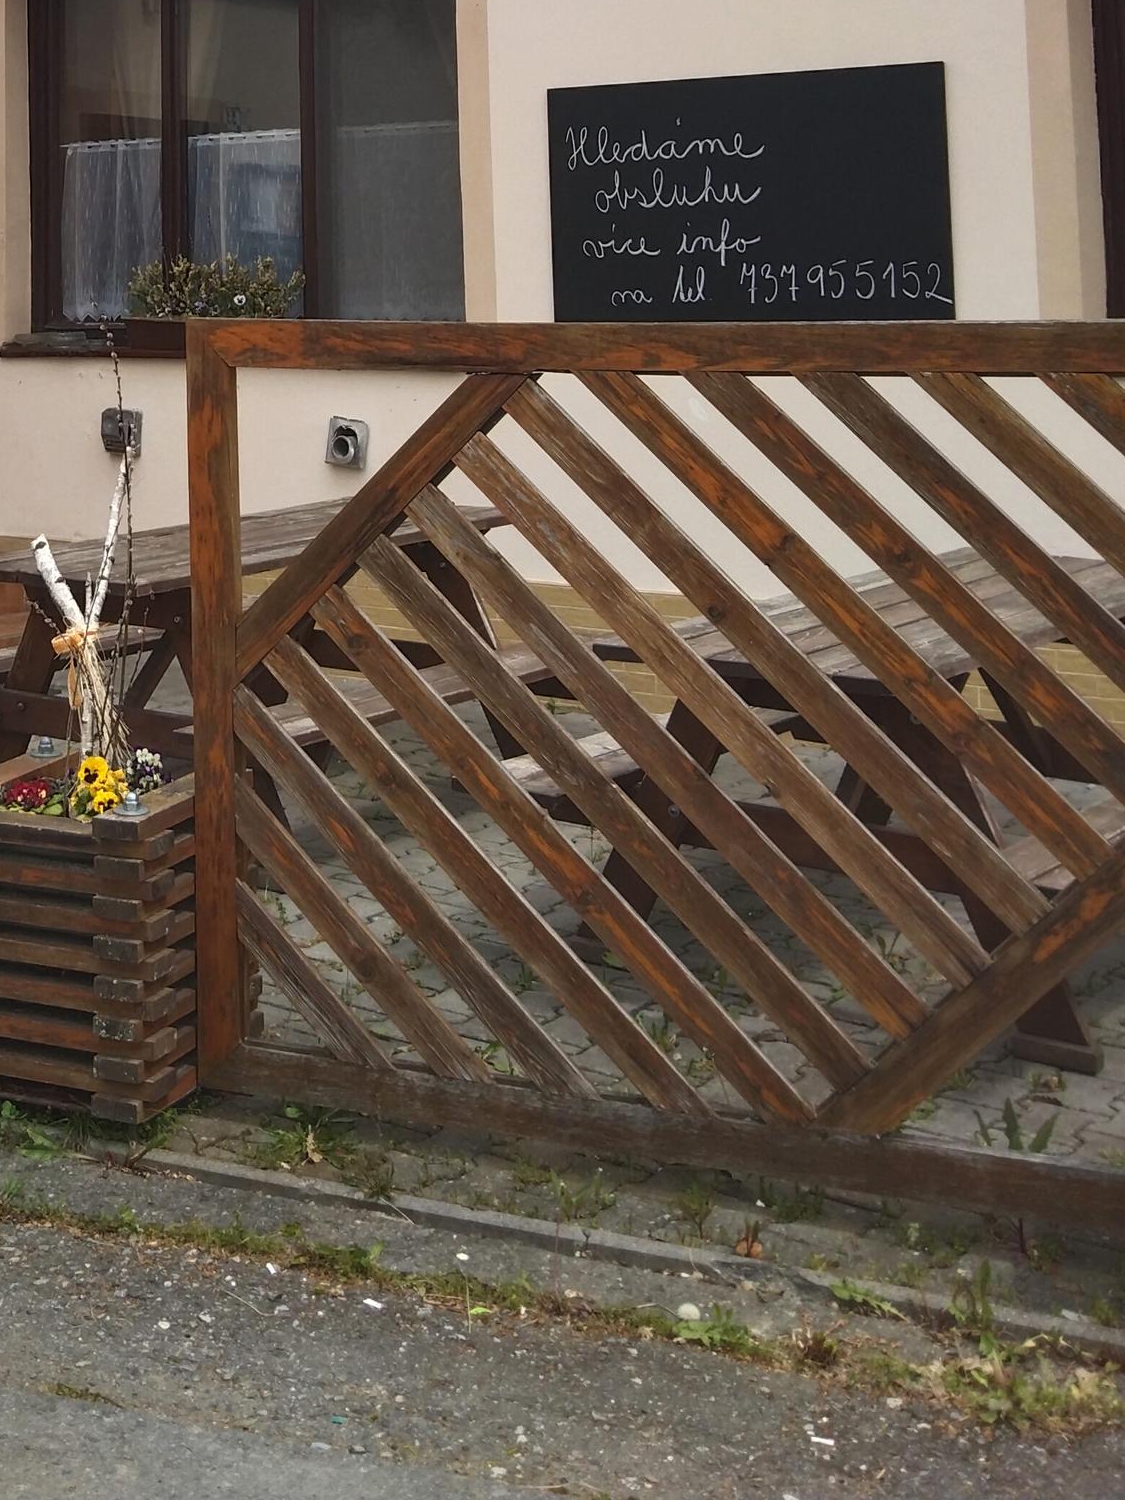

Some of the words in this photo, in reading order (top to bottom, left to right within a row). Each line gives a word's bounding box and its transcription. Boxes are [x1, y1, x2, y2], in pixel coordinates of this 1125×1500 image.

[565, 117, 764, 171] Hledáme
[595, 166, 762, 213] obsluhu
[582, 223, 661, 259] více
[677, 218, 761, 266] info
[611, 287, 653, 307] na
